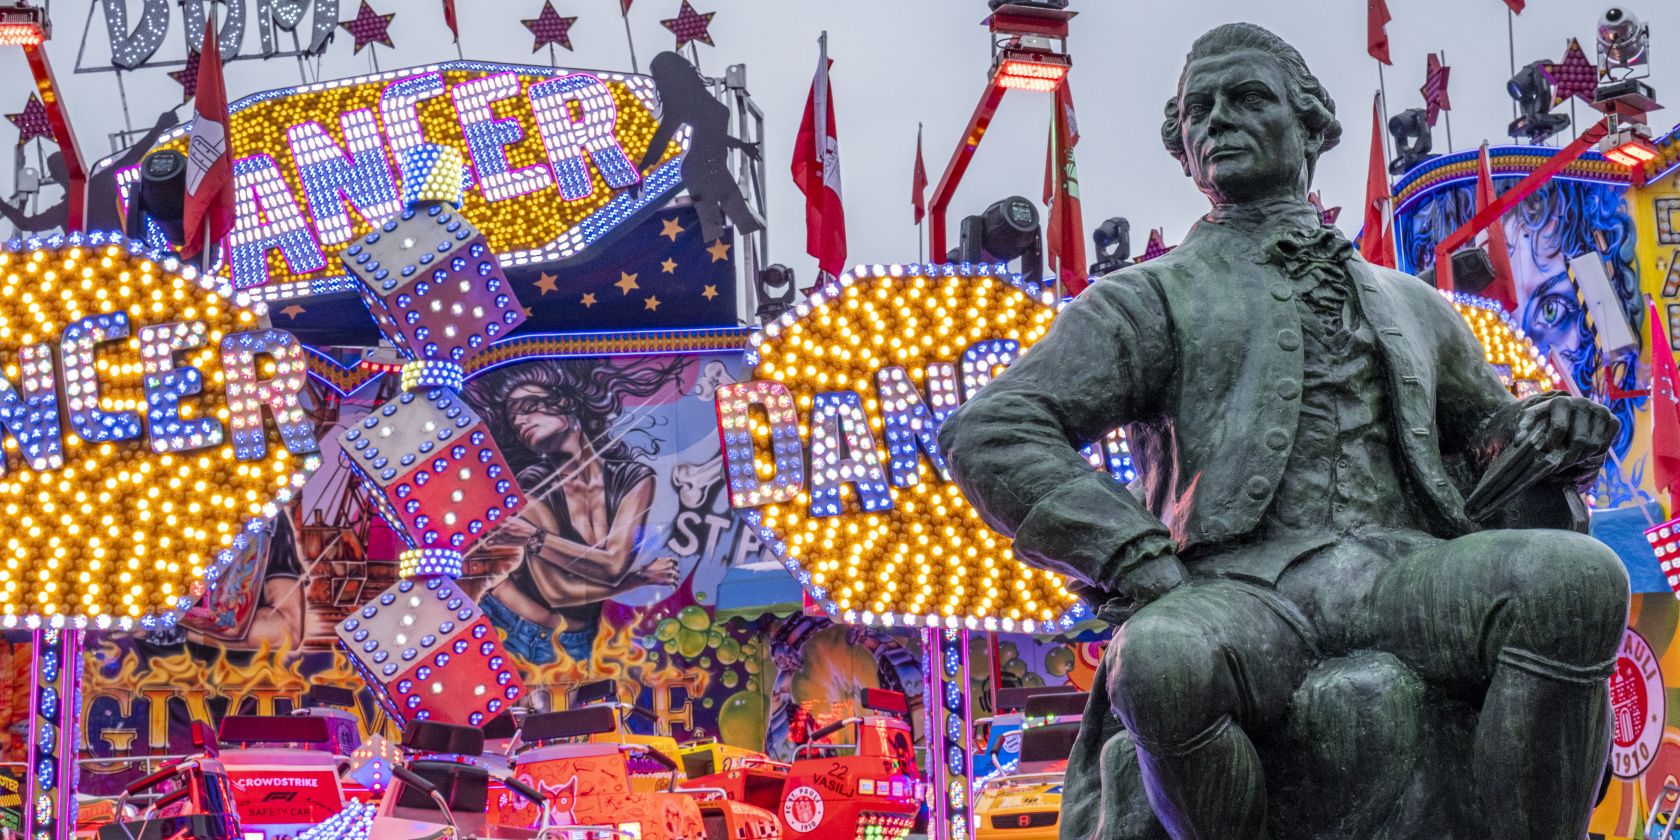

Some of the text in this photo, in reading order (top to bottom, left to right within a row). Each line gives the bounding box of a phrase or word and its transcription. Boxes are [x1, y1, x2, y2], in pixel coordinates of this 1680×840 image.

[1623, 633, 1658, 682] AULI
[1614, 741, 1650, 774] 1910
[828, 762, 848, 780] 22
[232, 777, 318, 791] CROWDSTRIKE
[812, 773, 855, 798] VASILJ
[249, 808, 310, 817] SAFETY CAR
[800, 821, 817, 831] 1910
